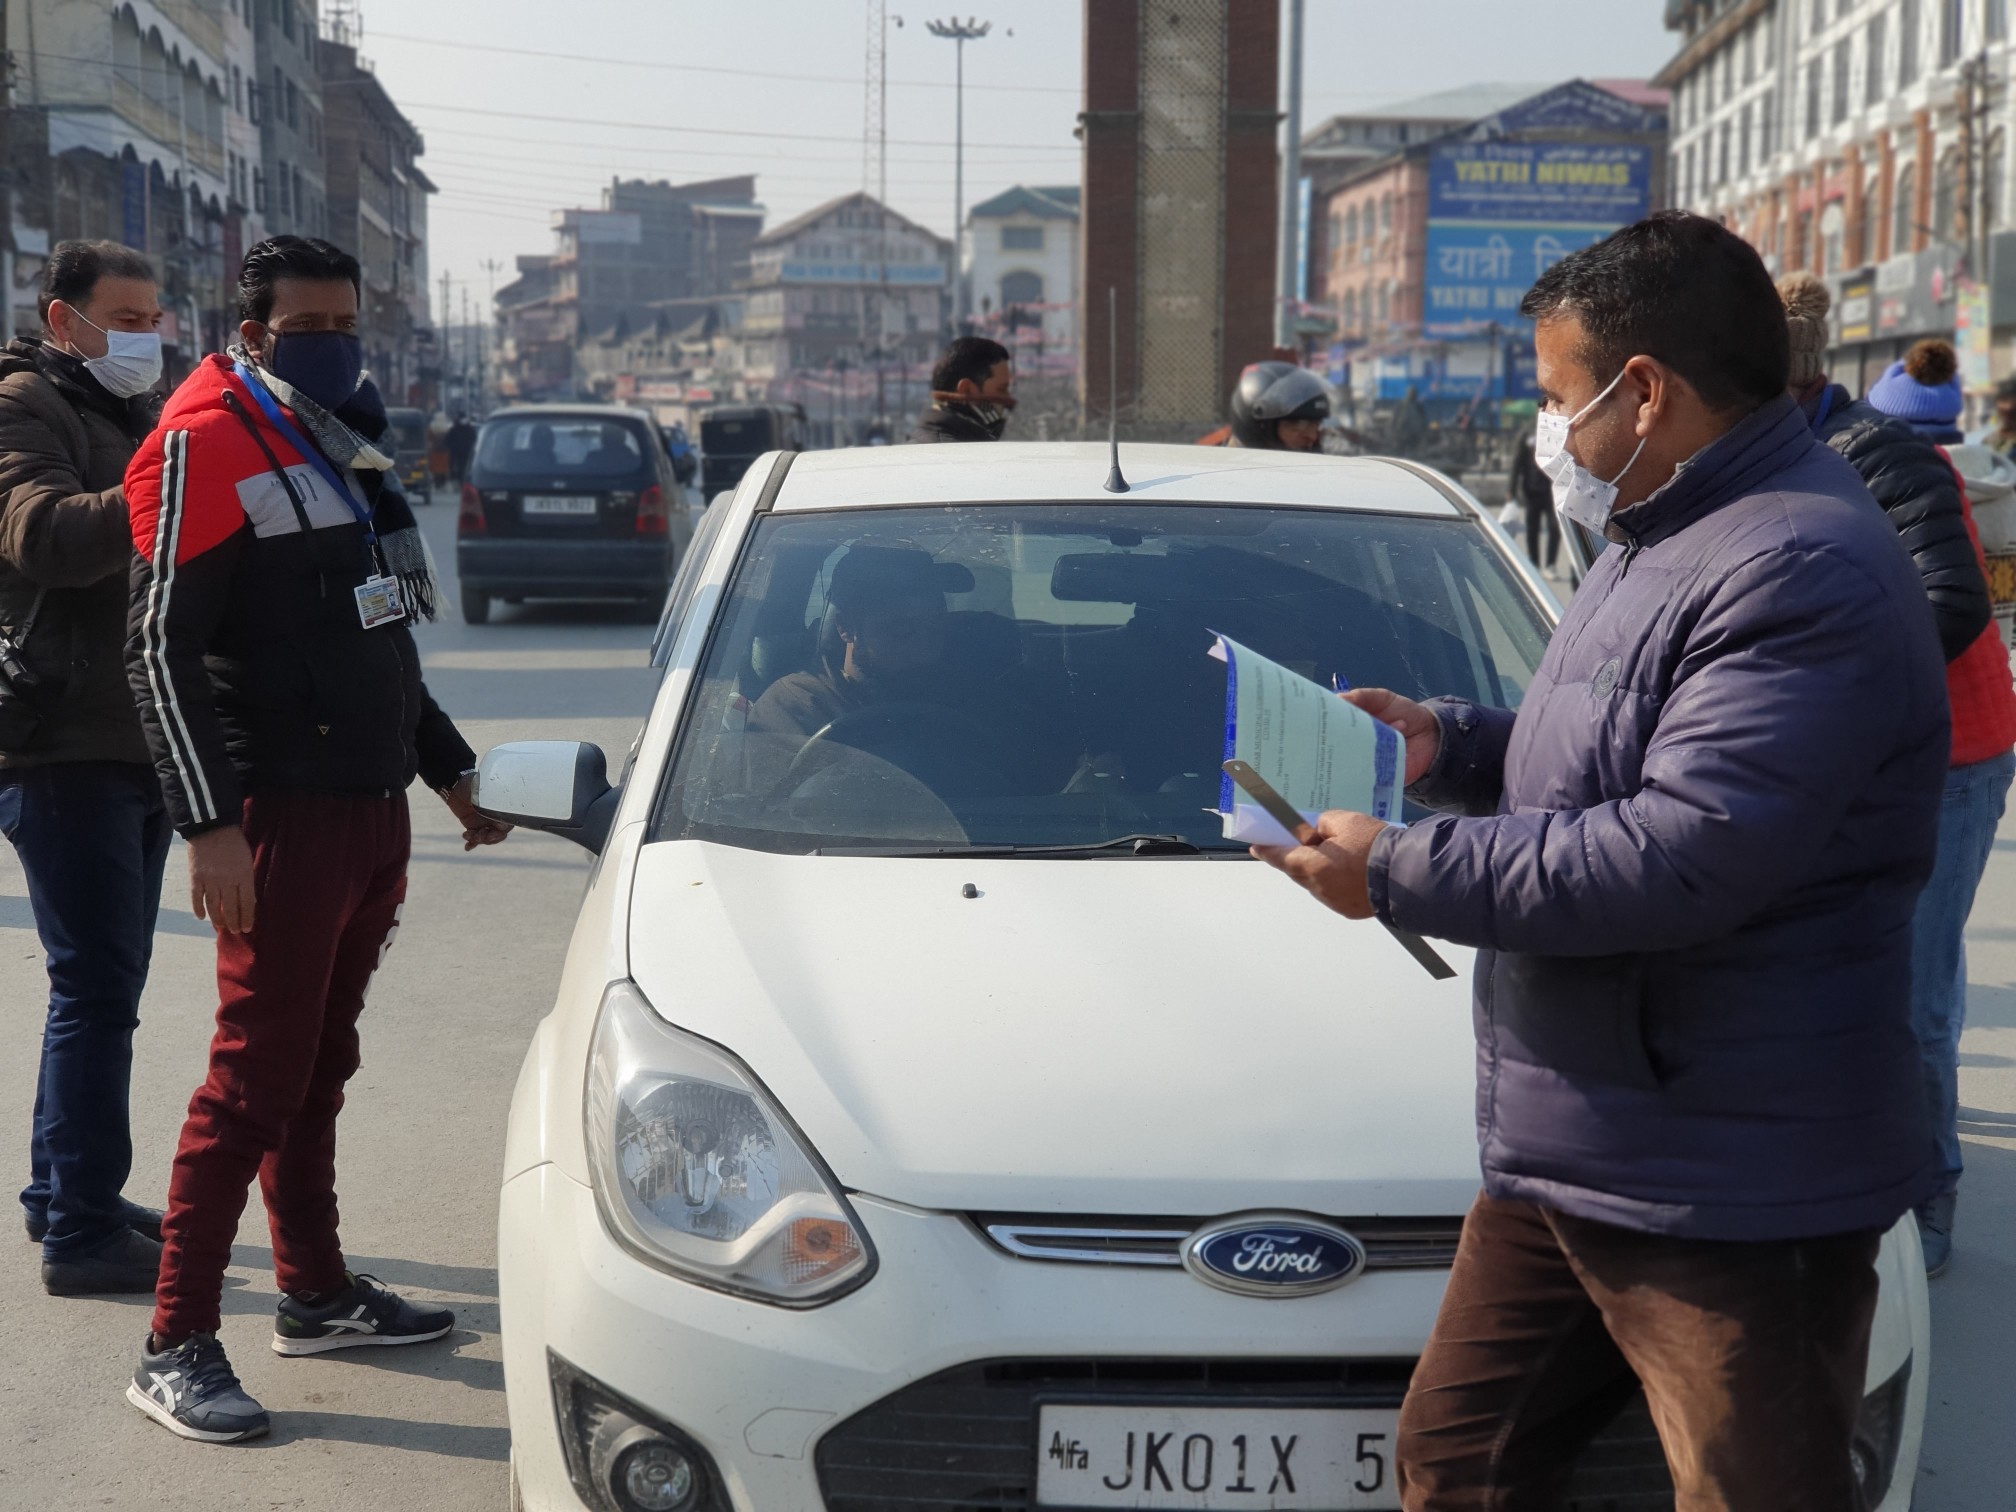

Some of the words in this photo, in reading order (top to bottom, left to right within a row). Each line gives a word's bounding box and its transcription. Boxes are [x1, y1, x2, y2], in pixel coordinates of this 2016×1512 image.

[1455, 160, 1530, 183] YATRI
[1536, 161, 1630, 186] NIWAS
[1438, 233, 1513, 279] यात्री
[1431, 286, 1488, 309] YATRI
[1232, 1233, 1324, 1273] Ford
[1102, 1431, 1298, 1493] JK01X
